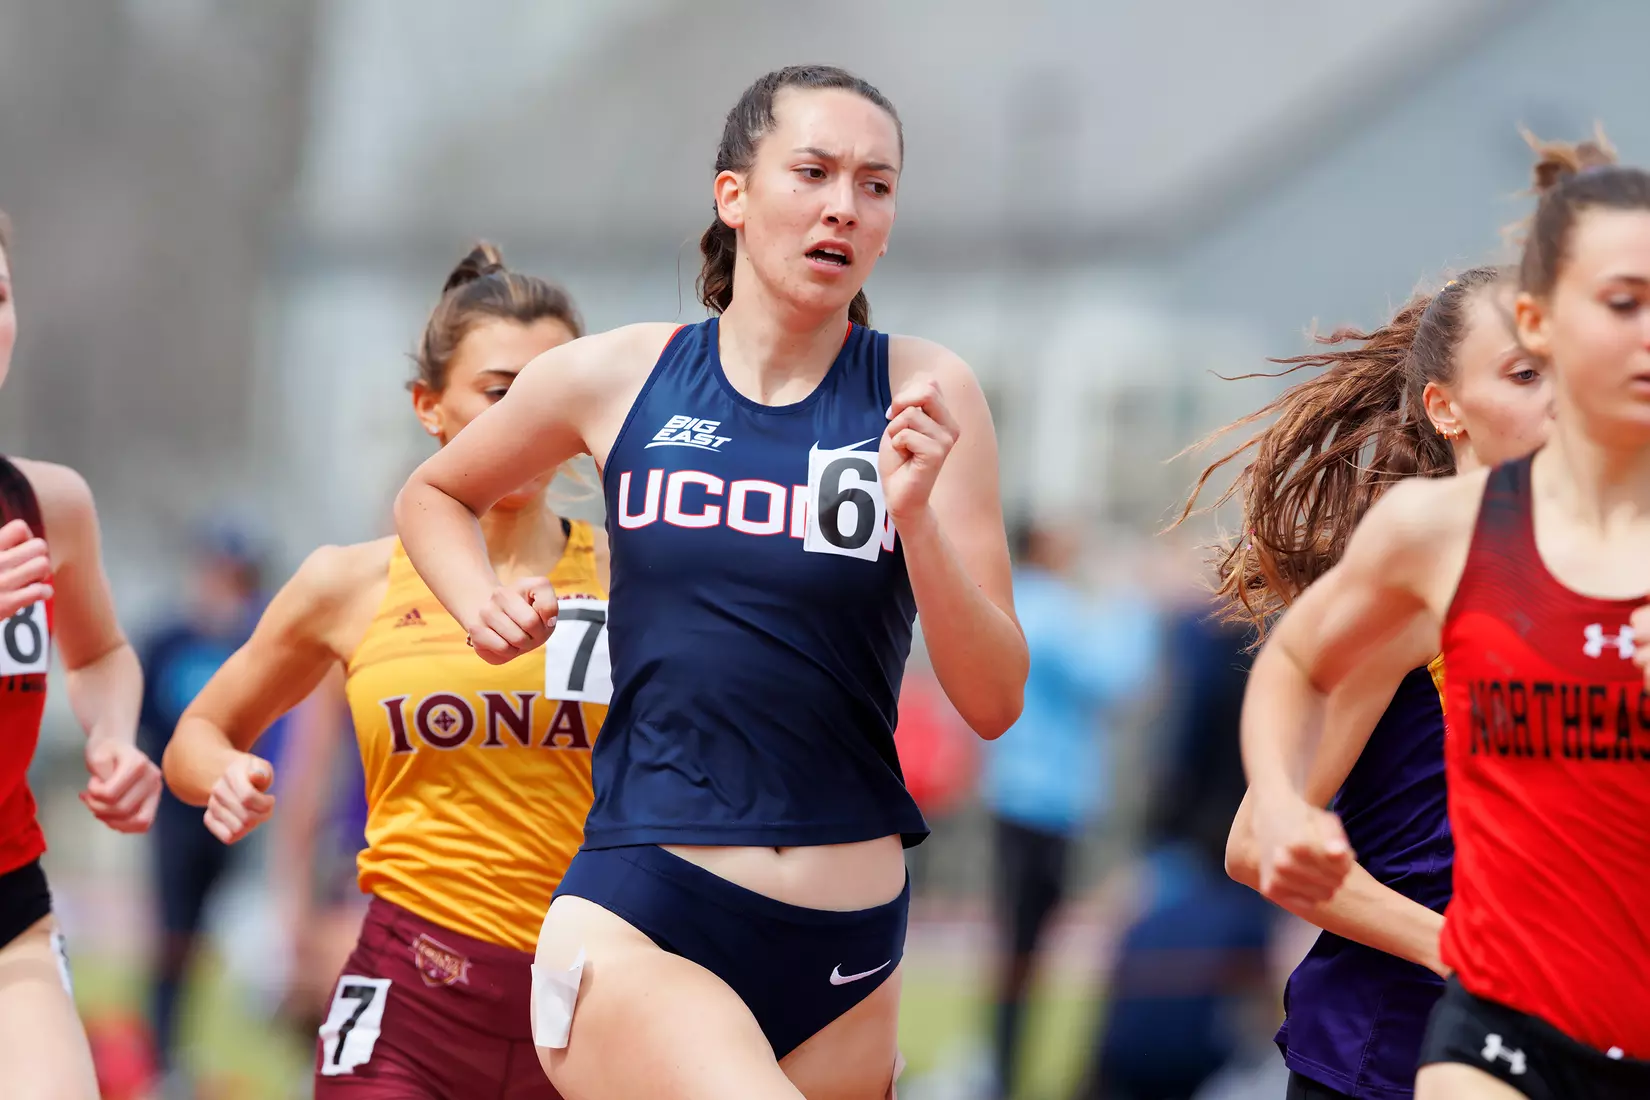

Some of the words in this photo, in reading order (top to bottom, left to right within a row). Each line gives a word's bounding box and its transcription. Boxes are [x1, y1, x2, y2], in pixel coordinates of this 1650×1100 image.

[652, 428, 733, 448] EAST
[663, 414, 721, 434] BIG
[618, 468, 897, 553] UCO
[817, 457, 878, 550] 6
[557, 608, 606, 692] 7
[379, 691, 592, 754] IONA
[332, 985, 377, 1065] 7
